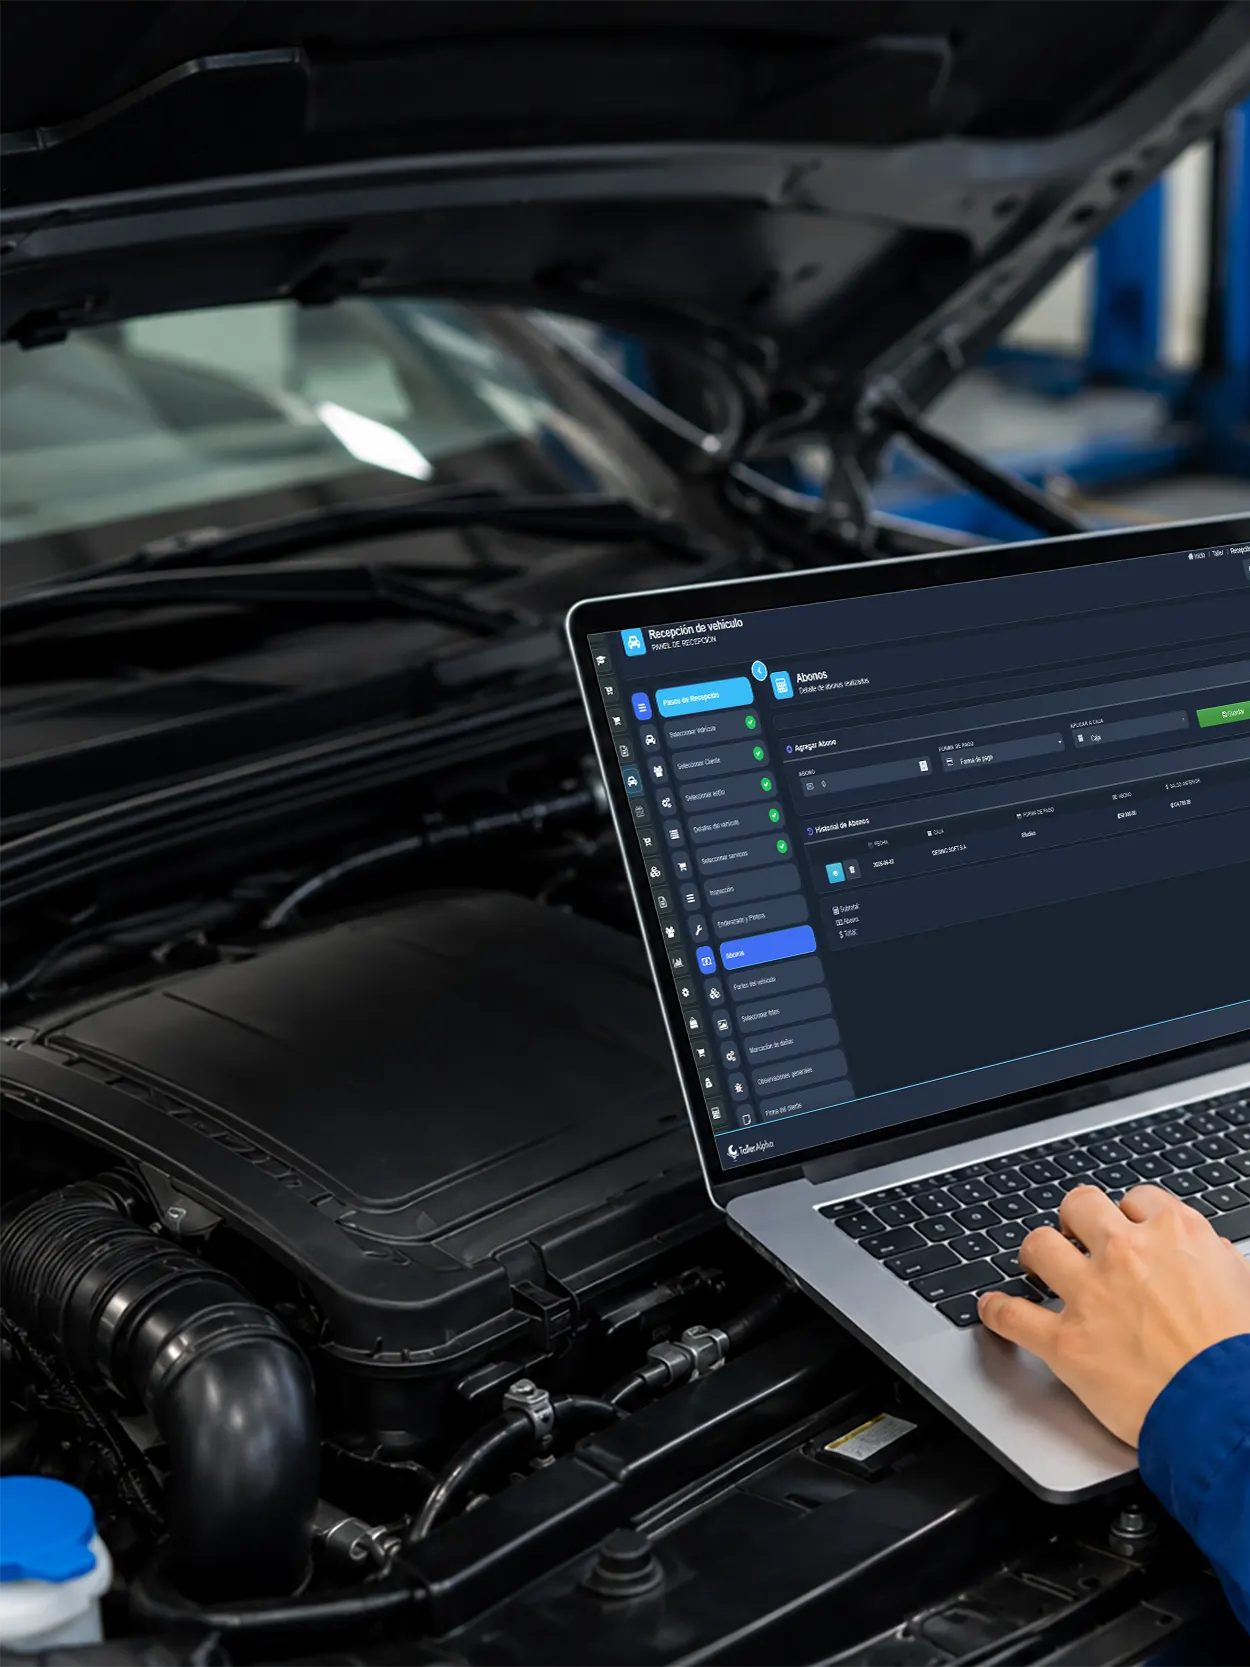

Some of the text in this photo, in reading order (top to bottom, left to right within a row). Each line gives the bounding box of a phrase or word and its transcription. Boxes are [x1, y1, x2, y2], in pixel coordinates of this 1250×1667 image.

[648, 624, 694, 640] Recepción
[695, 623, 707, 633] de
[651, 642, 672, 651] PANEL
[681, 635, 717, 647] RECEPCIÓN
[796, 670, 828, 683] Abonos
[798, 685, 817, 694] Detalle
[662, 698, 681, 706] Pasos
[794, 739, 837, 752] Agregar Abono
[815, 823, 839, 834] Historial
[848, 818, 870, 828] Abonos
[757, 1066, 813, 1085] Observaciones generales
